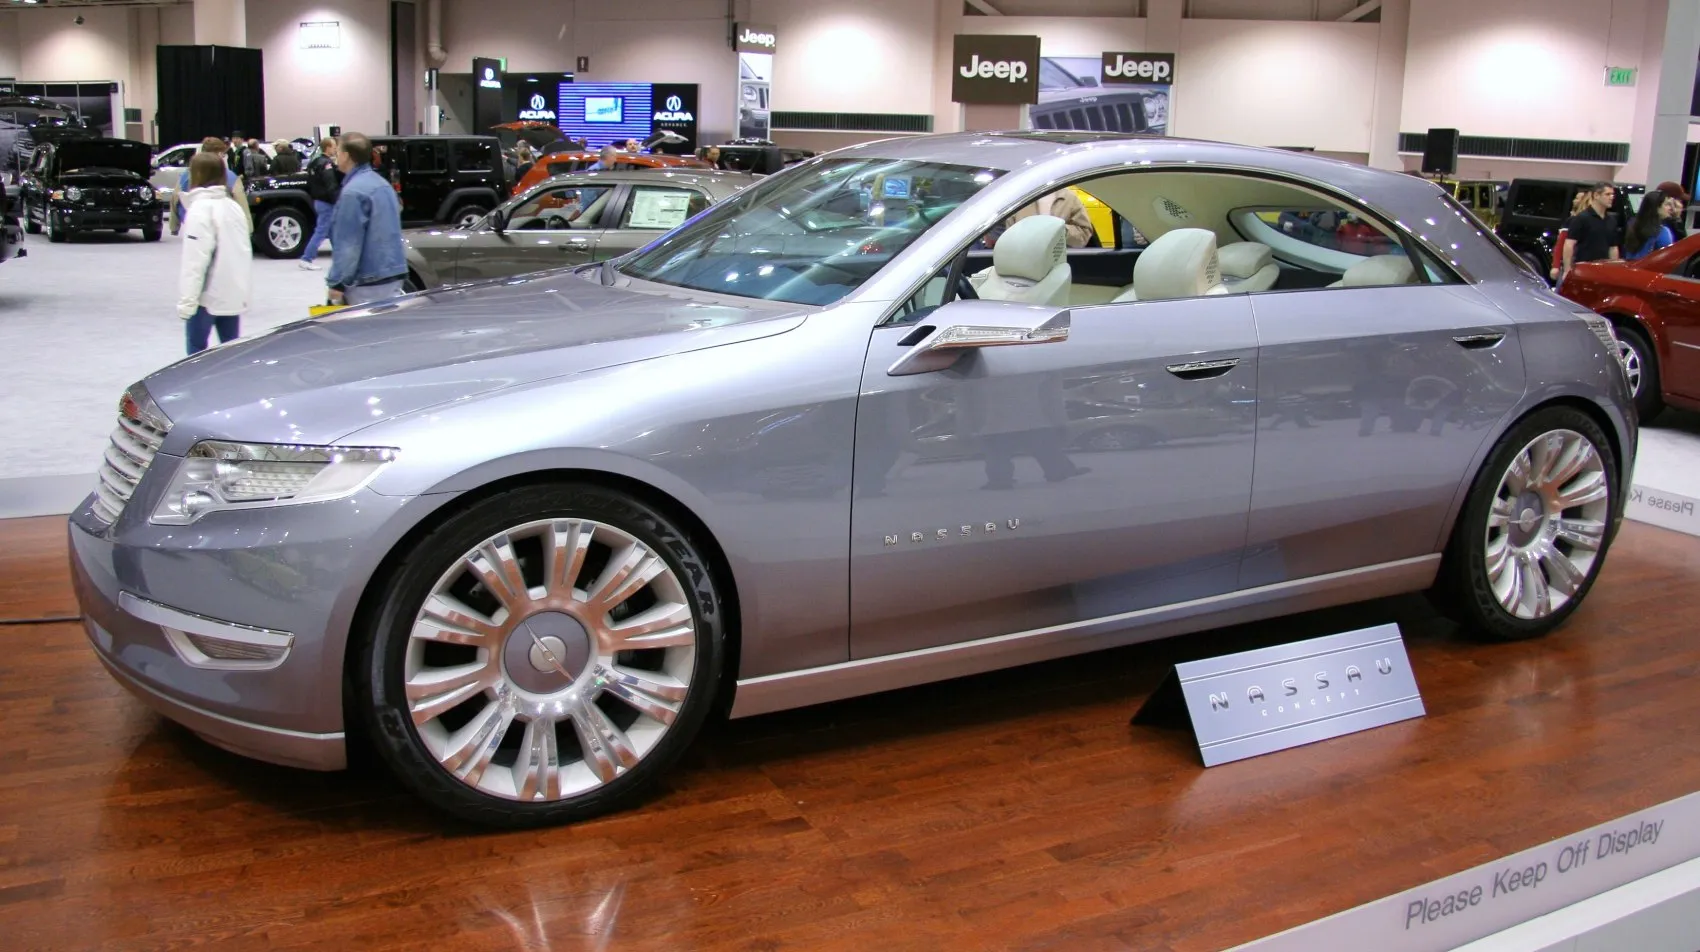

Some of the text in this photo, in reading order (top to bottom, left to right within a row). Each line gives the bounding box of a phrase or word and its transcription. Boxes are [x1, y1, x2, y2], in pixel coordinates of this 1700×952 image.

[739, 28, 776, 47] Jeep
[959, 54, 1028, 83] Jeep
[1104, 54, 1170, 82] Jeep
[1610, 70, 1632, 84] EXIT
[518, 110, 557, 120] ACURA
[653, 111, 694, 121] ACURA
[884, 517, 1021, 547] NASSAU
[1208, 656, 1393, 712] NASSAU
[1261, 687, 1361, 717] CONCEPT
[1405, 818, 1665, 930] Please Keep Off Display
